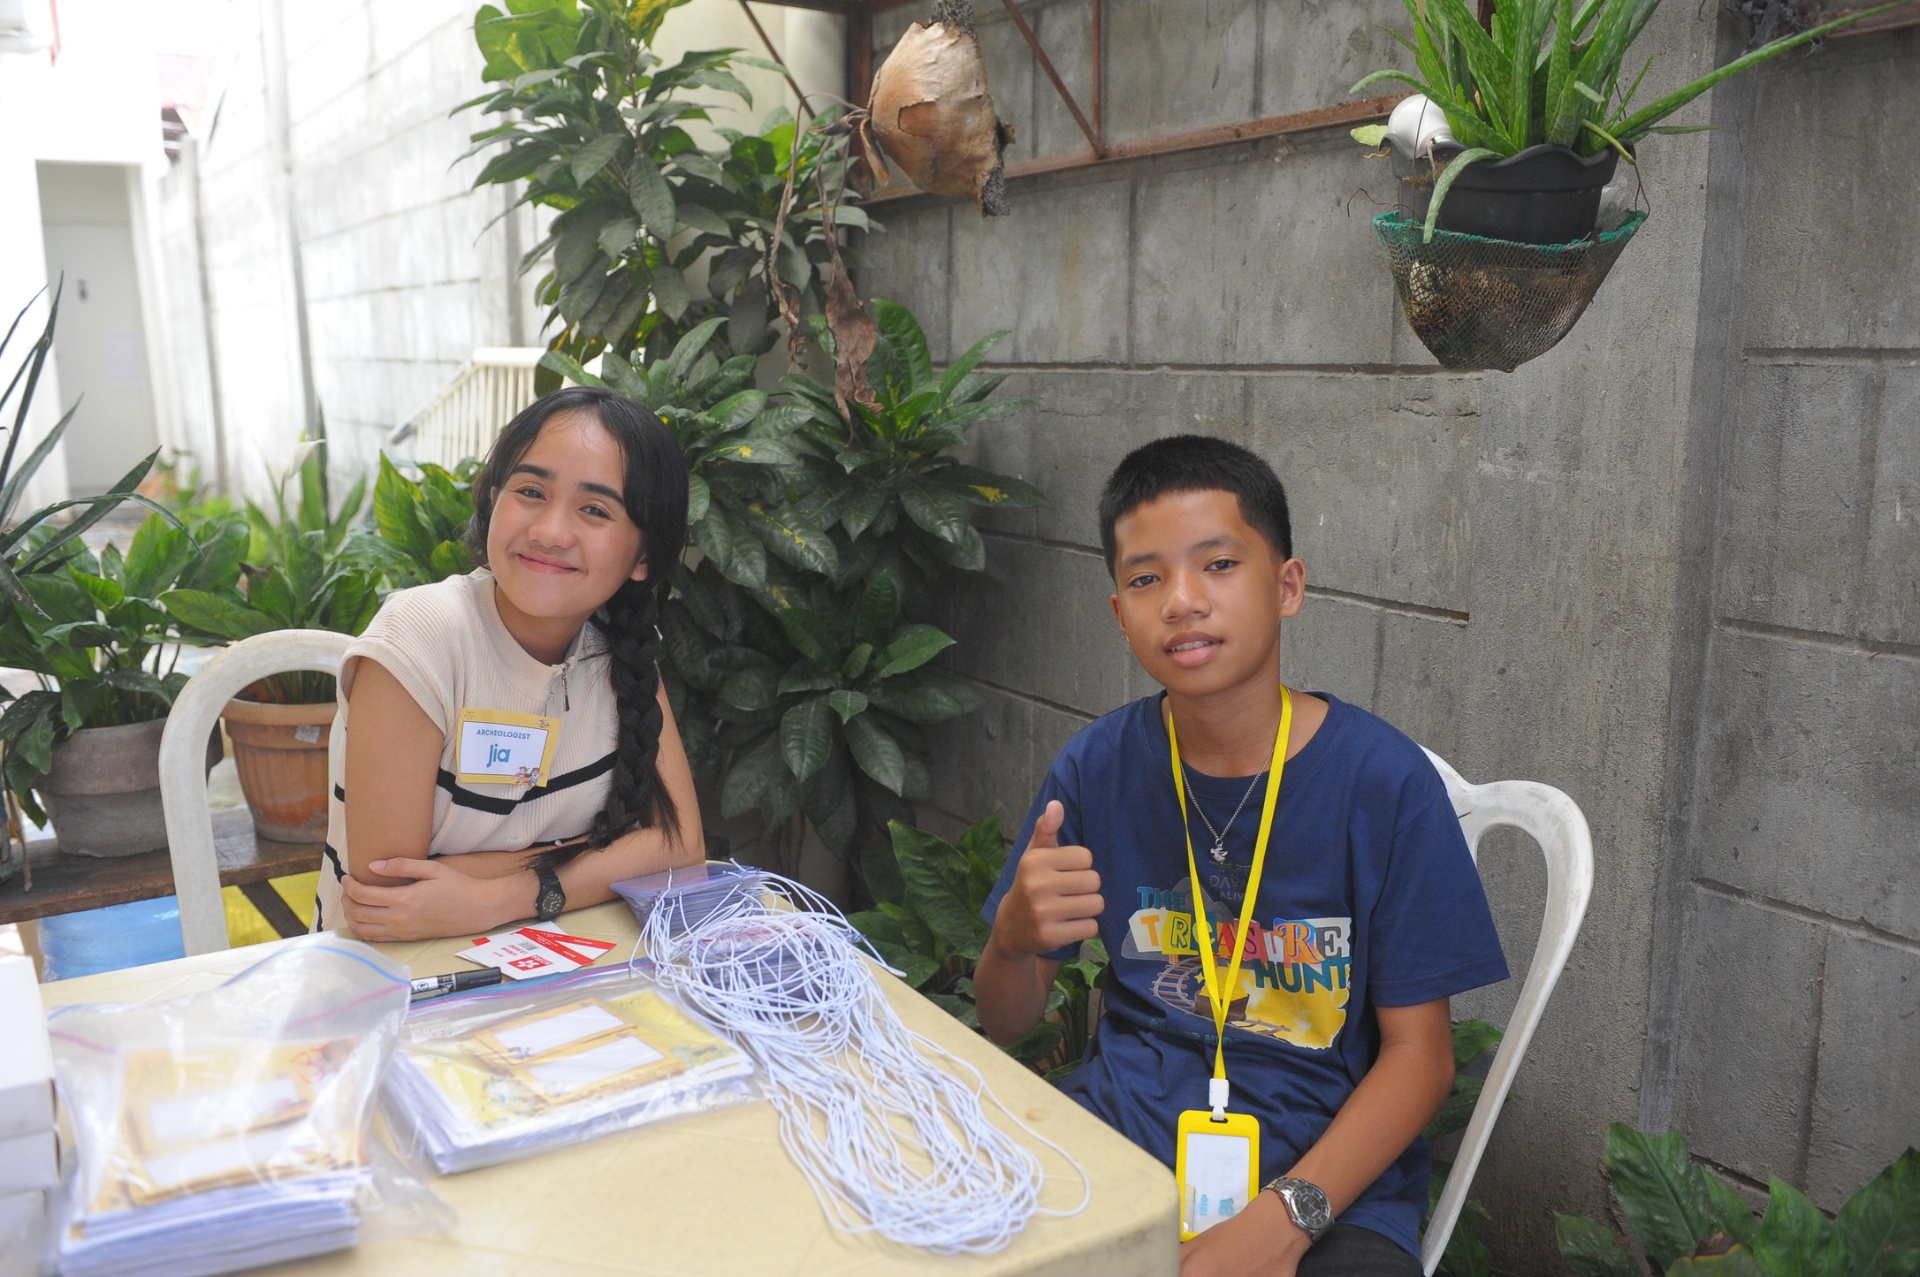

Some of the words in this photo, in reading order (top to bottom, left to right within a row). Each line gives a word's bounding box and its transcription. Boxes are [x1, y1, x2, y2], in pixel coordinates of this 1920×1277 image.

[476, 729, 531, 740] ARCHEOLOGIST
[1137, 886, 1186, 912] THE
[1219, 890, 1245, 900] ALIV
[1252, 956, 1352, 994] HUNT
